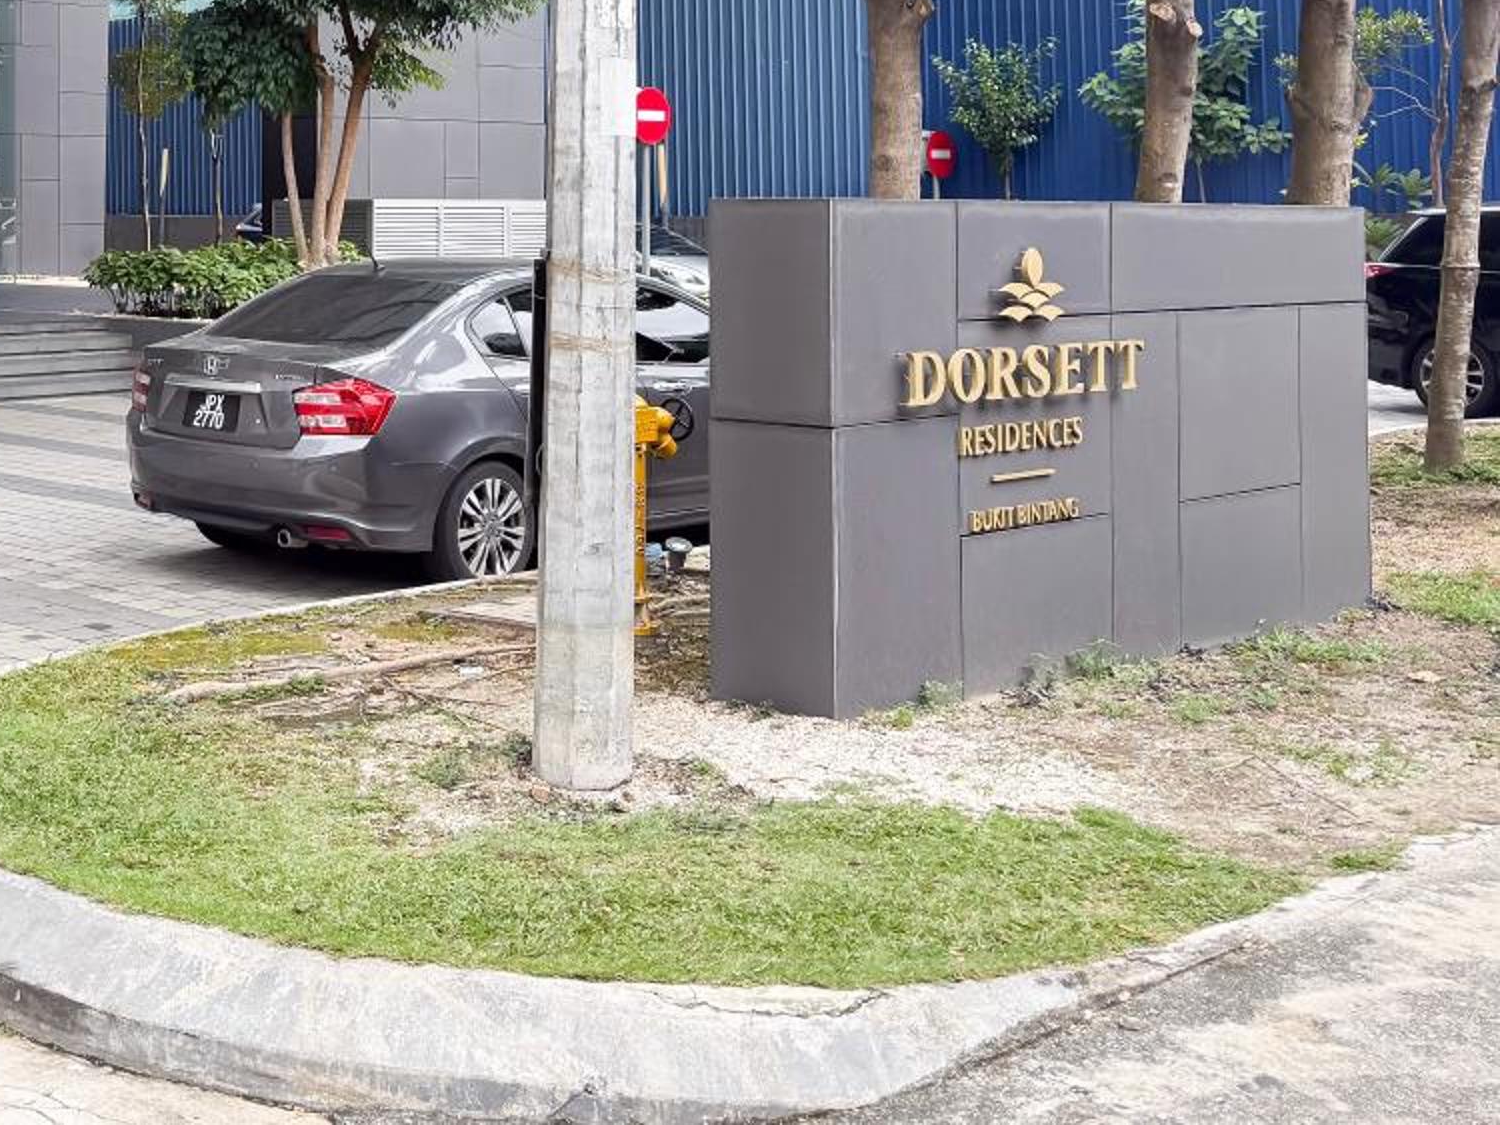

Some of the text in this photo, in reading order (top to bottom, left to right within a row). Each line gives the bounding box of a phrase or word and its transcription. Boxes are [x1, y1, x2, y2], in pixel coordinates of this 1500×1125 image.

[900, 339, 1145, 407] DORSETT
[193, 409, 225, 430] 2770
[200, 394, 225, 412] JPX
[959, 416, 1084, 457] RESIDENCES
[970, 497, 1080, 533] BUKIT BINTANG
